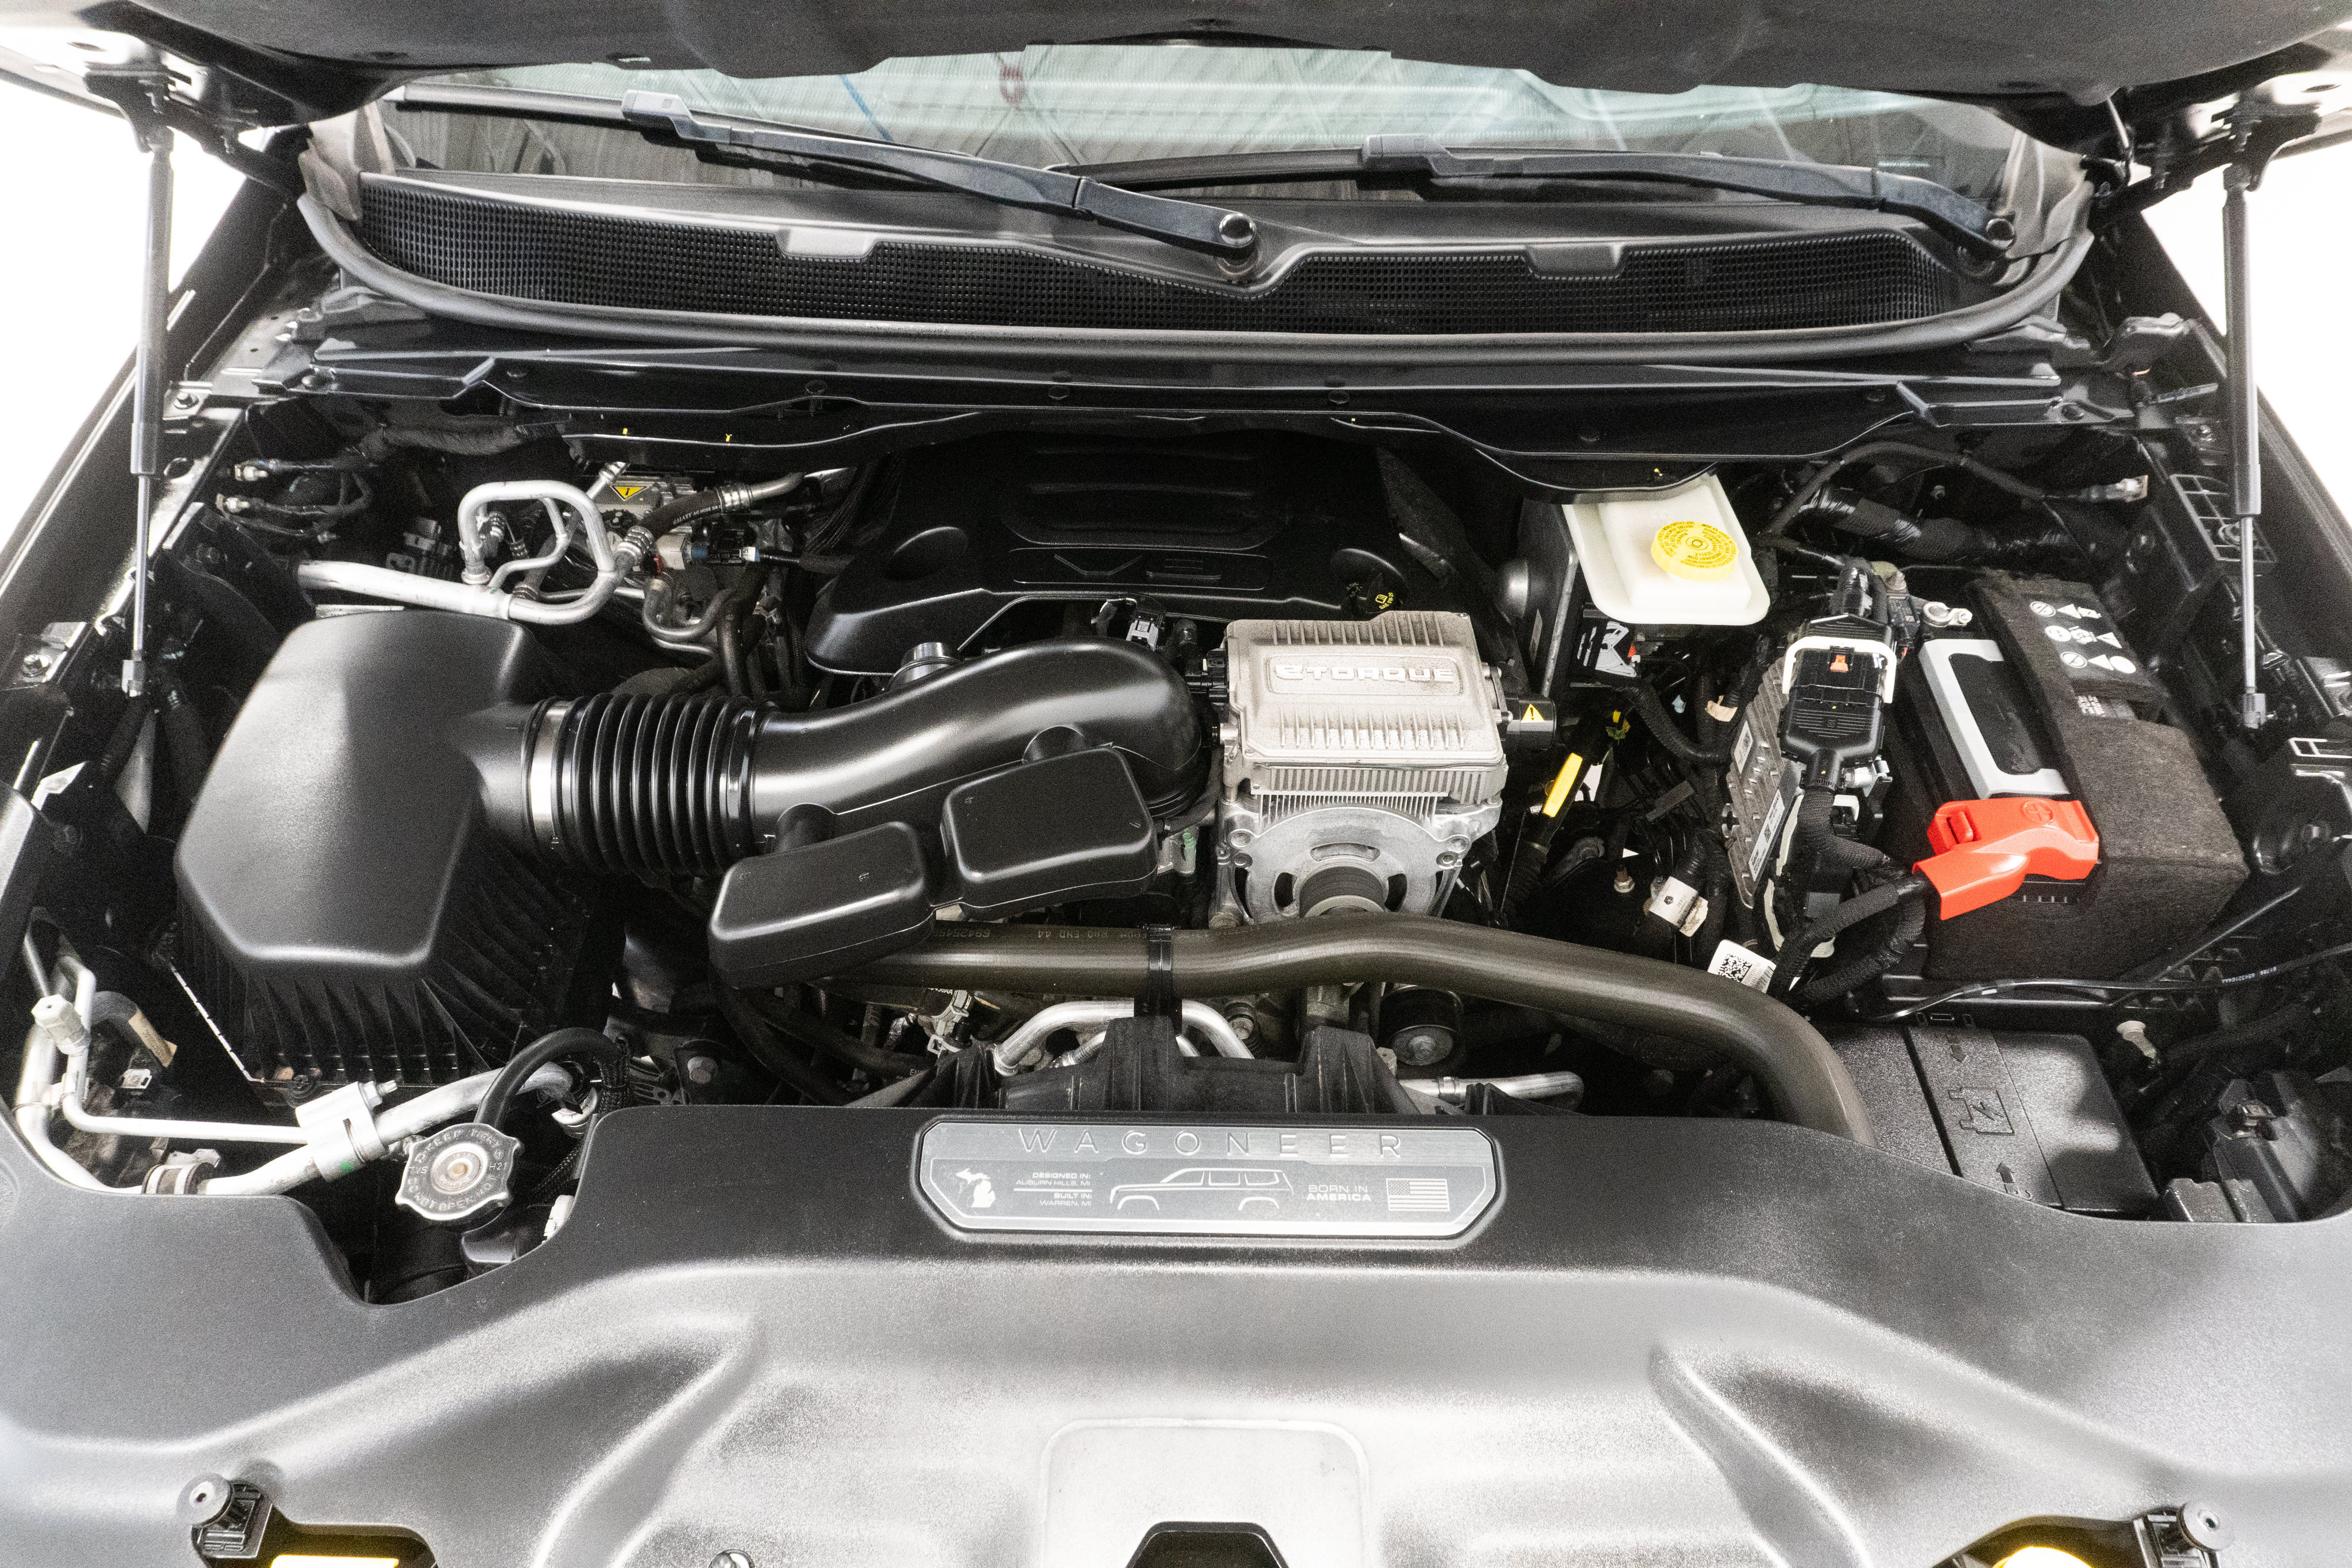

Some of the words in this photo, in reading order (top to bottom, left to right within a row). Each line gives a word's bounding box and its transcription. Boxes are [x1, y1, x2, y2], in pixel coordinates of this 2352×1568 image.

[673, 512, 691, 525] GALAXY
[1018, 1129, 1402, 1158] WAGONEER
[1308, 1184, 1349, 1193] BORN
[1355, 1184, 1368, 1193] IN
[1306, 1193, 1372, 1202] AMERICA
